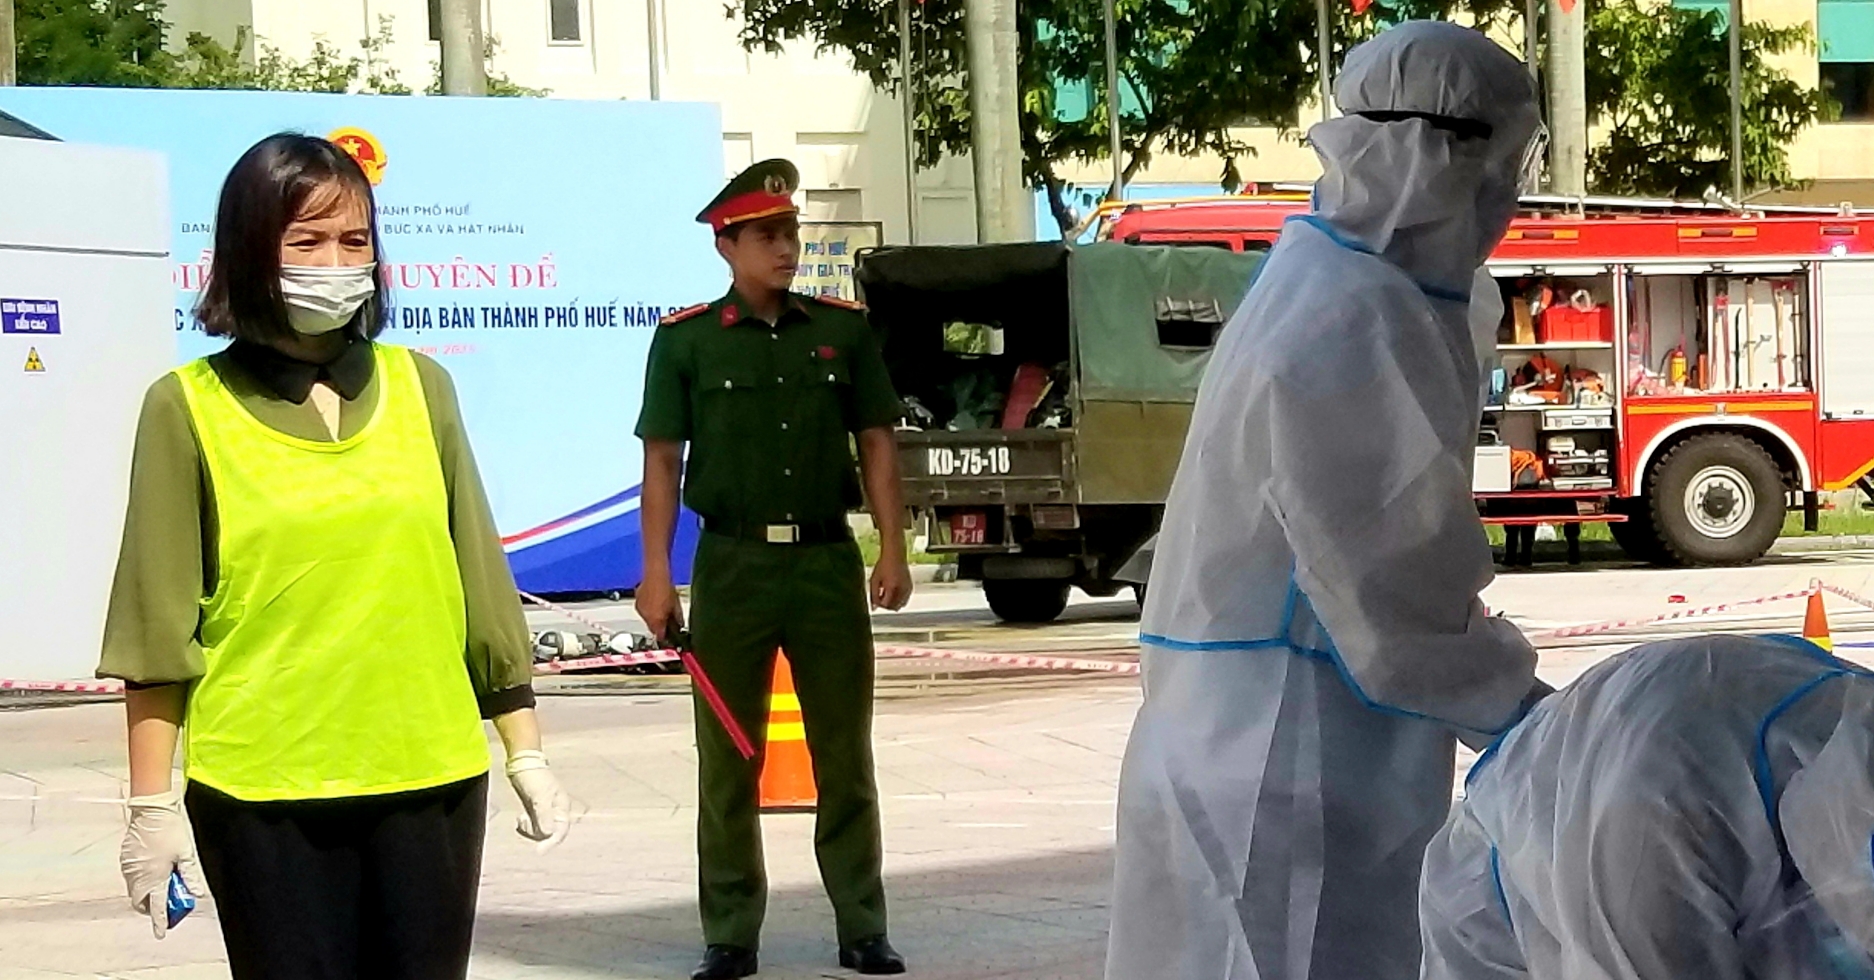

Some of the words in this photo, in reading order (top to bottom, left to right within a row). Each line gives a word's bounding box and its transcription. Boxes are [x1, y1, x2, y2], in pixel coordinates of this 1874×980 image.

[181, 222, 211, 234] BAN
[403, 306, 433, 335] ĐỊA
[439, 302, 475, 329] BÀN
[481, 302, 539, 329] THÀNH
[545, 297, 579, 328] PHỐ
[584, 297, 619, 328] HUẾ
[623, 300, 662, 328] NĂM
[928, 447, 1011, 475] KD-75-18
